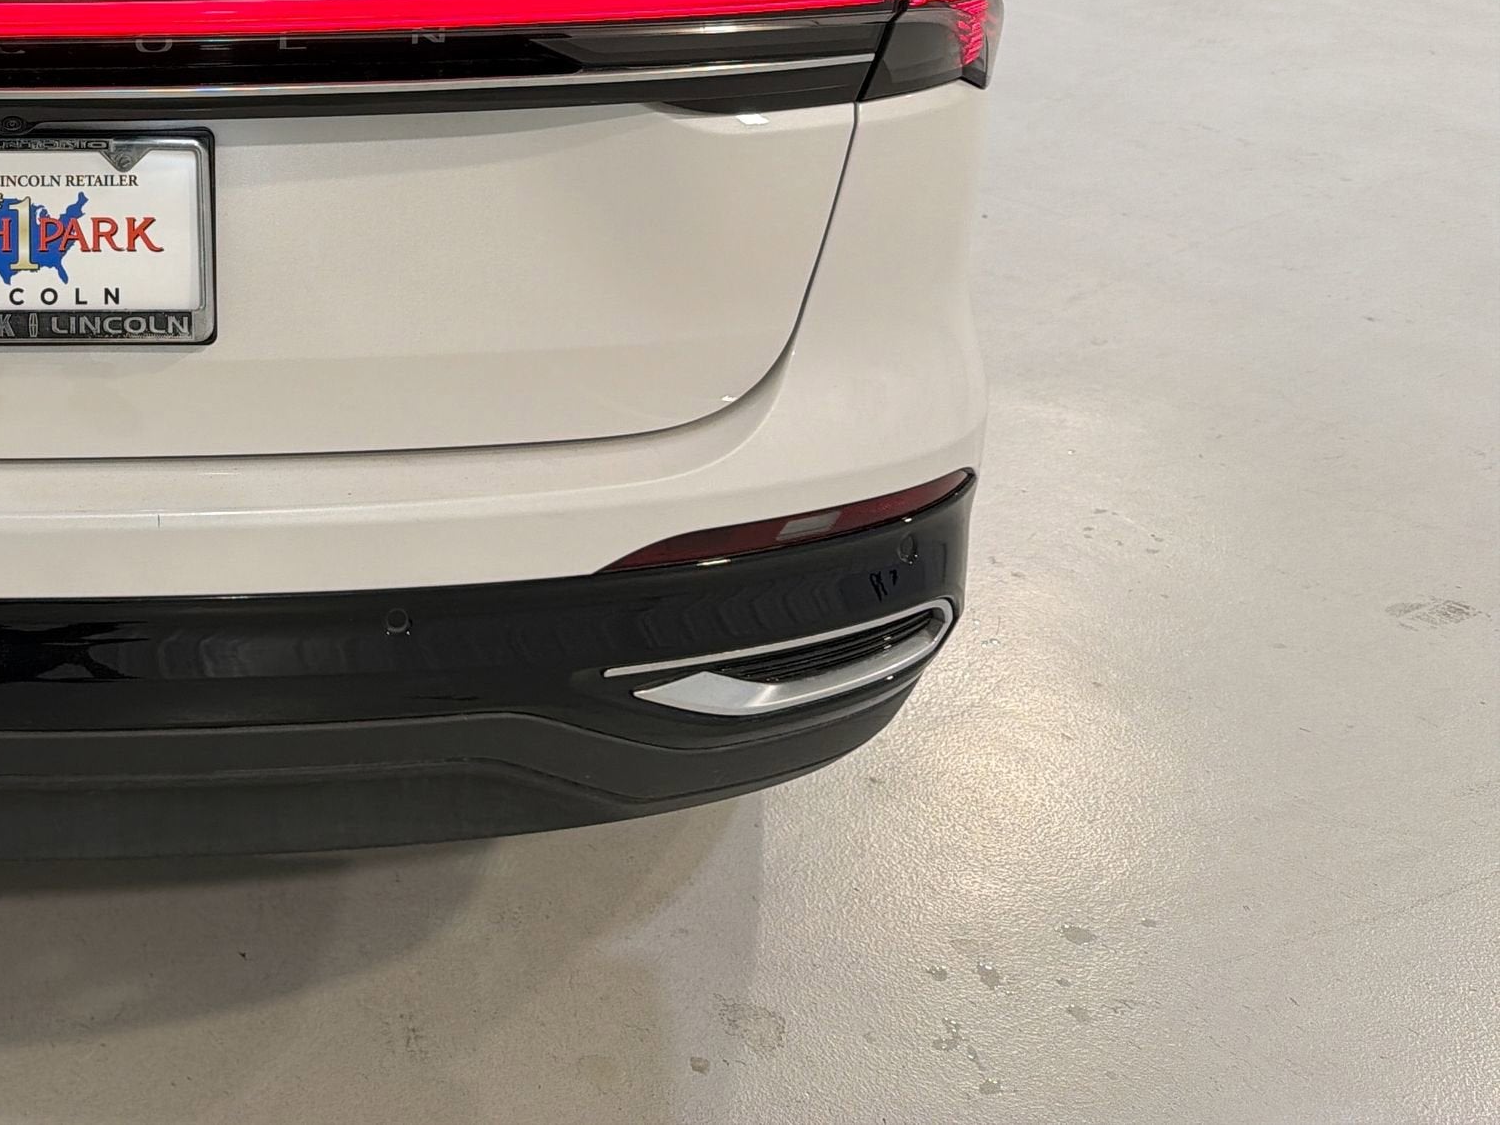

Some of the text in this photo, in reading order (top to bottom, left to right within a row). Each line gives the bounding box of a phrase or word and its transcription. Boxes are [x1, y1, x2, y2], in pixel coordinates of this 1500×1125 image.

[65, 175, 139, 187] RETAILER
[38, 217, 164, 252] PARK
[51, 315, 190, 336] LINCOLN
